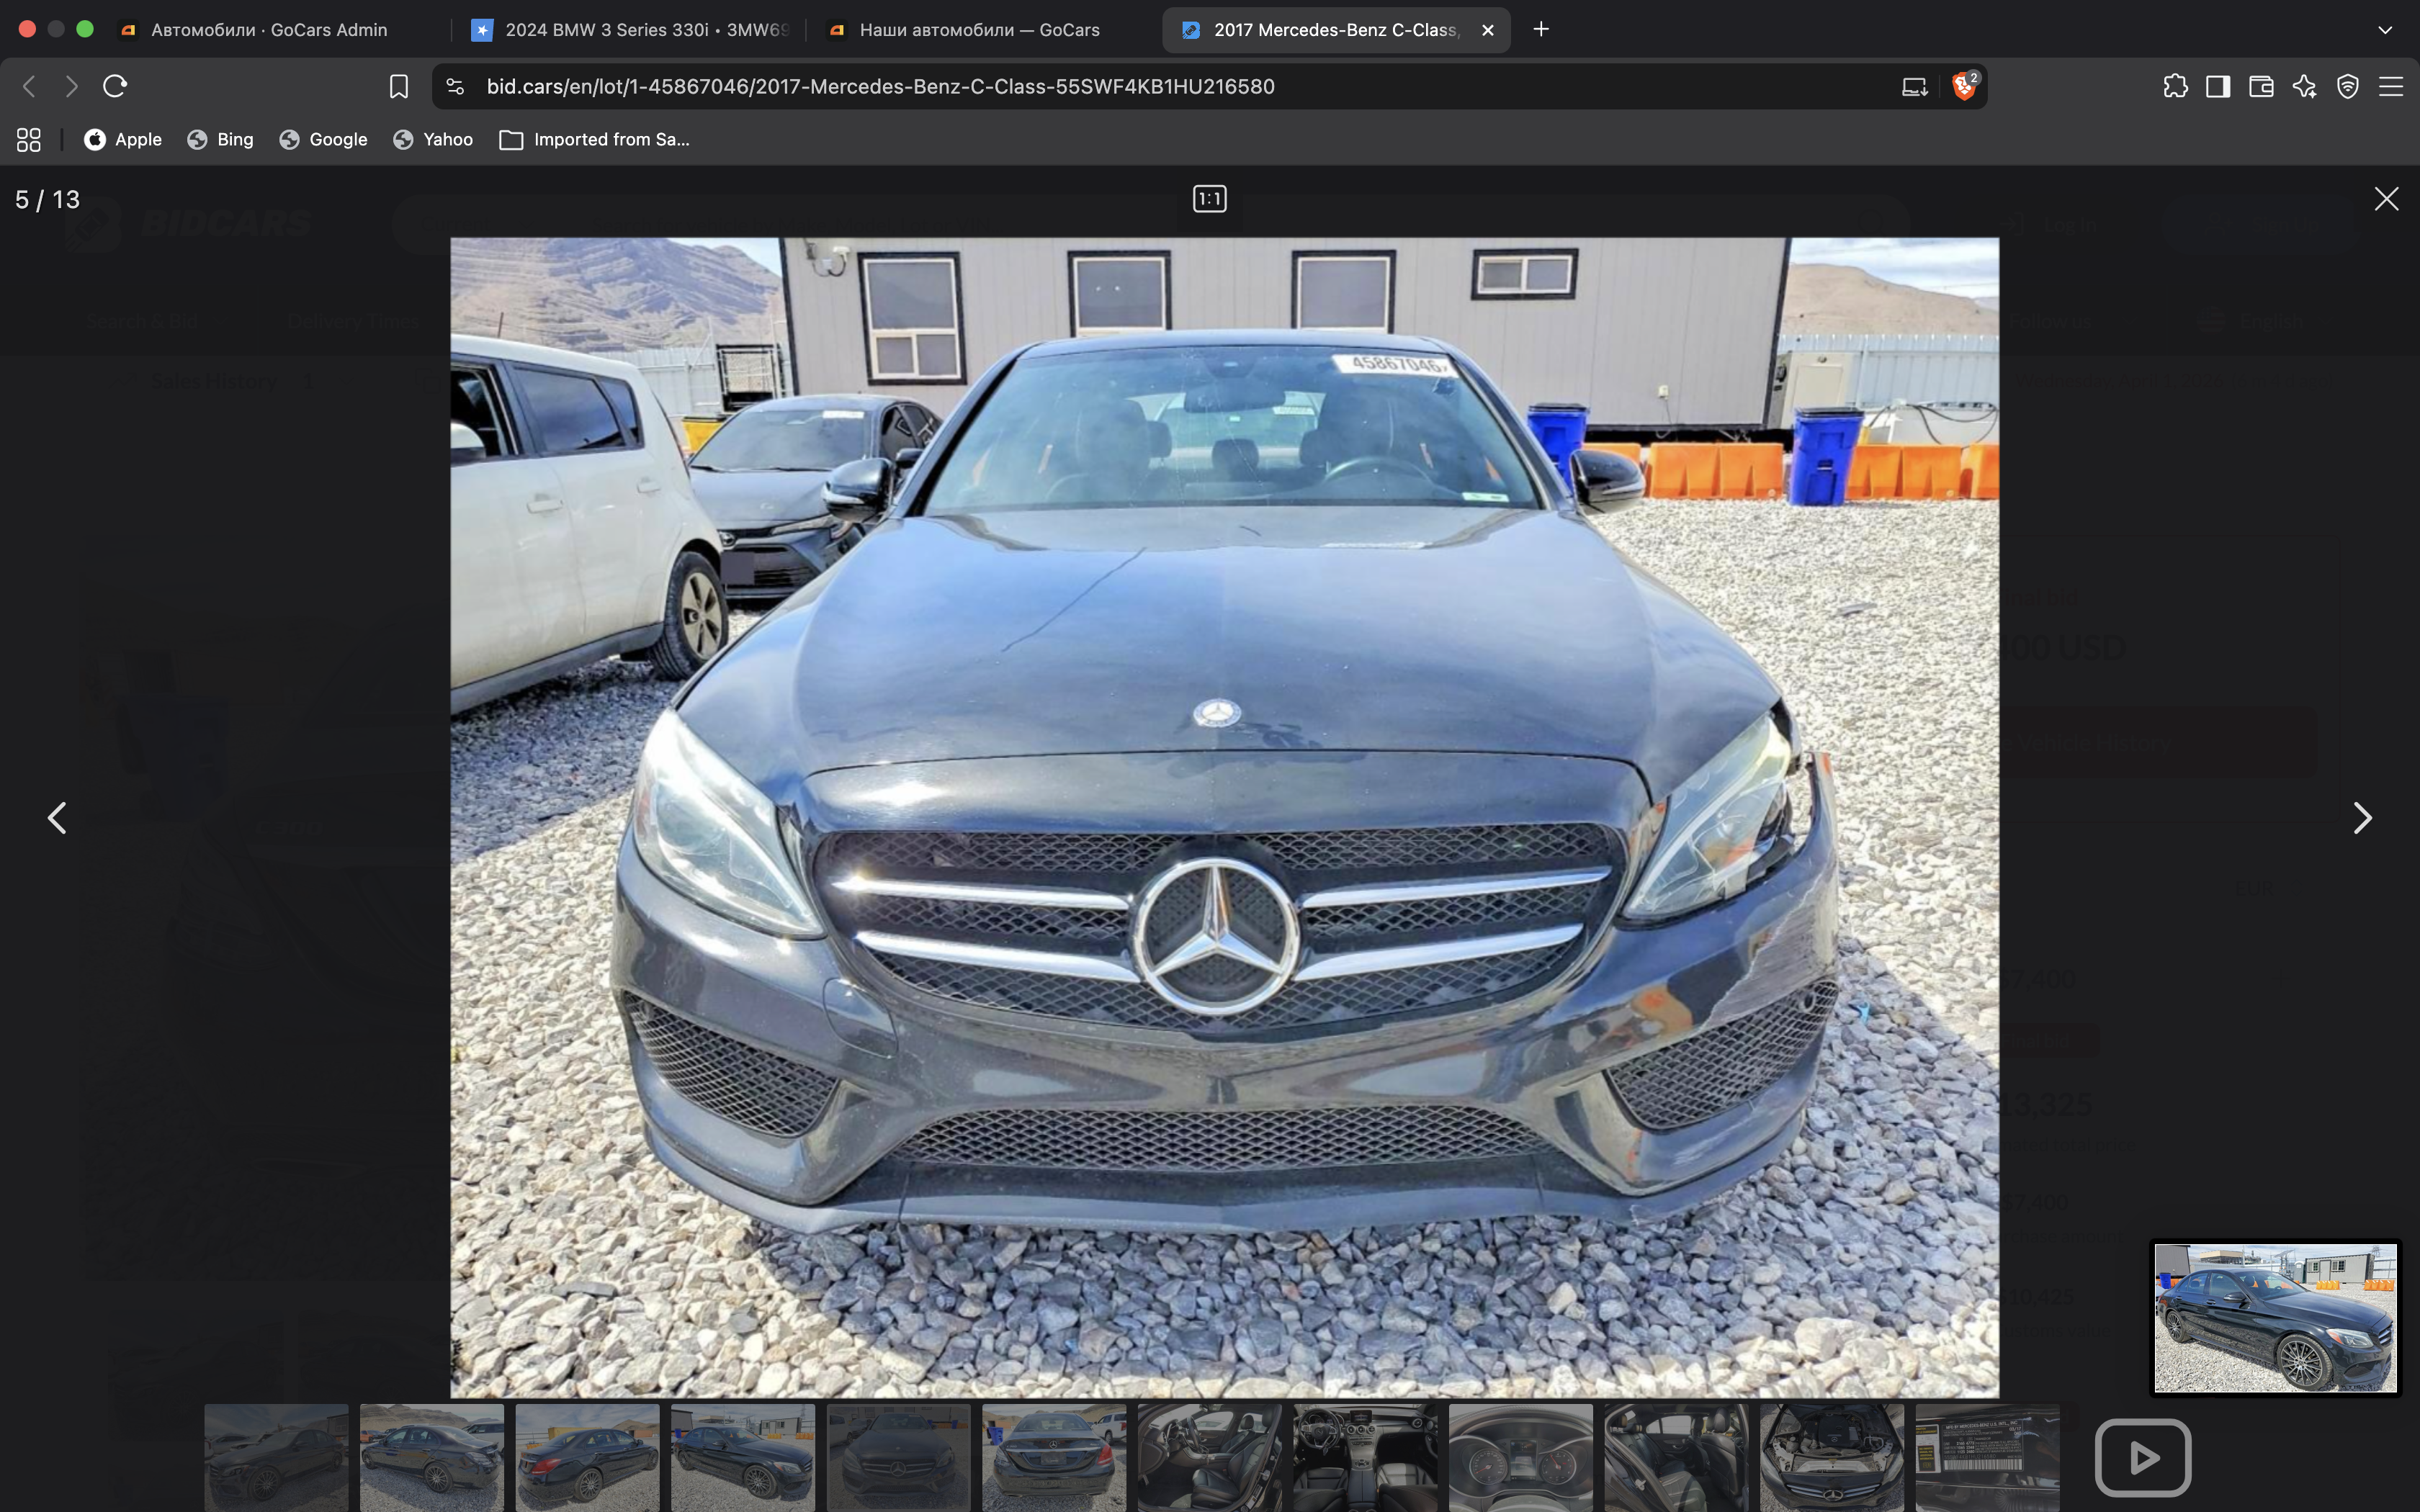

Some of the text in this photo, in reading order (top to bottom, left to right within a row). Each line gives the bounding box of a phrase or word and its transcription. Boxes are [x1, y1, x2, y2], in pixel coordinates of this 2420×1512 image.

[152, 23, 255, 36] Автомобили
[272, 23, 331, 37] GoCars
[337, 23, 387, 36] Admin
[506, 23, 547, 37] 2024
[554, 23, 596, 36] BMW
[601, 23, 611, 37] 3
[617, 23, 667, 37] Series
[673, 23, 708, 37] 330i
[861, 24, 906, 36] Наши
[913, 23, 1013, 36] автомобили
[1040, 23, 1100, 37] GoCars
[1215, 23, 1252, 37] 2017
[1260, 23, 1386, 37] Mercedes-Benz
[1971, 73, 1977, 82] 2
[488, 78, 1274, 97] bid.cars/en/lot/1-45867046/2017-Mercedes-Benz-C-Class-55SWF4KB1HU216580
[115, 132, 161, 149] Apple
[219, 132, 253, 149] Bing
[310, 132, 367, 149] Google
[424, 132, 472, 145] Yahoo
[536, 132, 607, 149] Imported
[614, 132, 650, 145] from
[16, 189, 79, 212] 5 / 13
[1200, 192, 1219, 205] 1:1
[141, 210, 312, 236] BIDCARS
[2045, 217, 2096, 236] Log In
[1353, 356, 1441, 372] 45867046
[2059, 634, 2126, 661] USD
